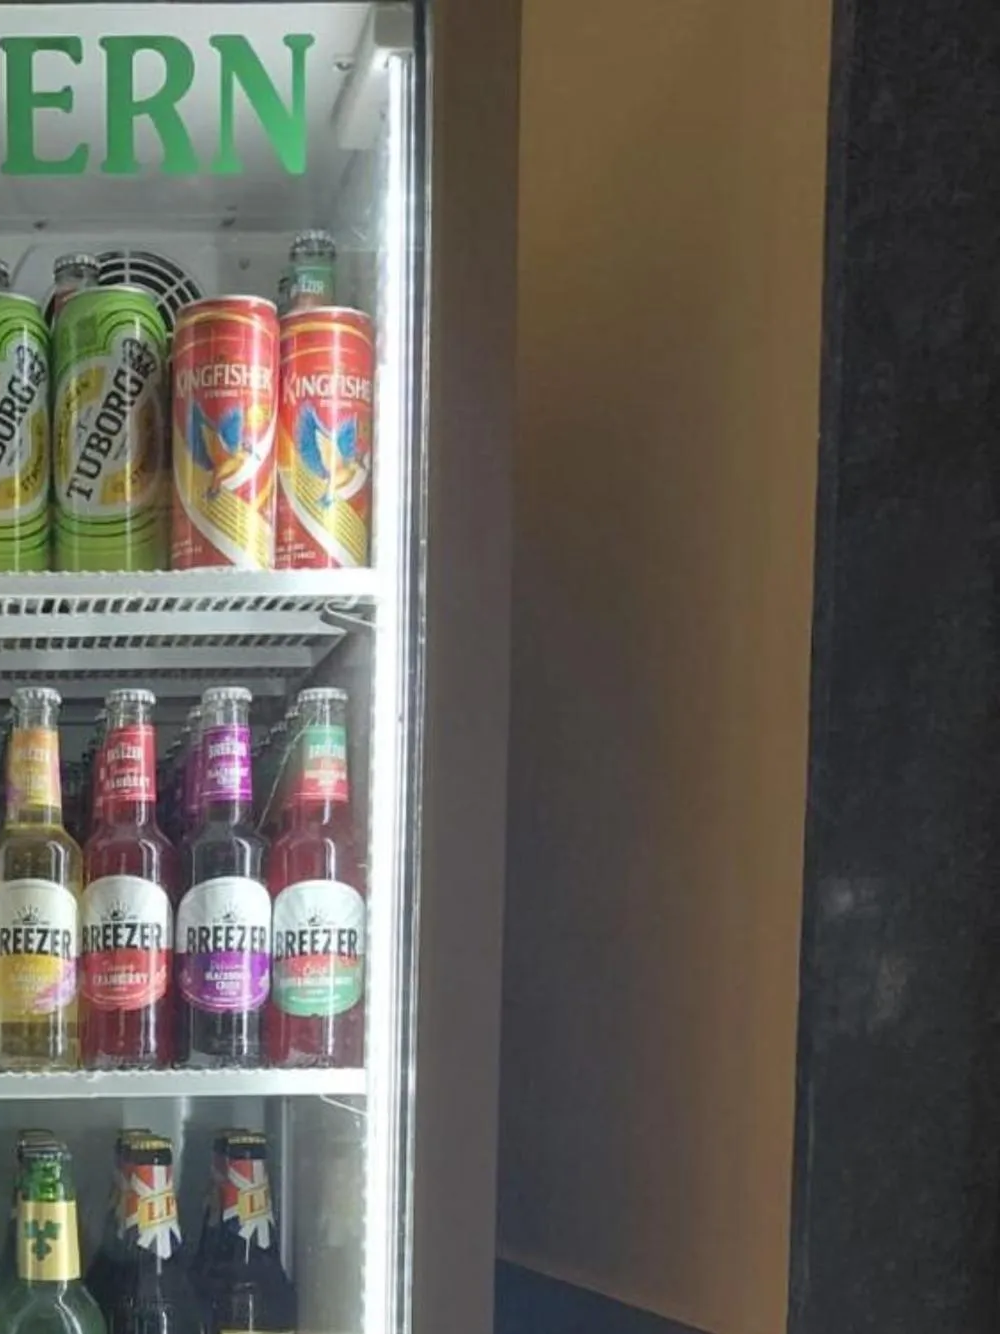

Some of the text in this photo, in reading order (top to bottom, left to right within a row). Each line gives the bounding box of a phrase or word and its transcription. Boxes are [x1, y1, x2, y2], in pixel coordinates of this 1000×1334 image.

[66, 368, 146, 502] TUBORG
[82, 922, 163, 953] BREEZER
[187, 925, 267, 956] BREEZER
[275, 927, 358, 962] BREEZER
